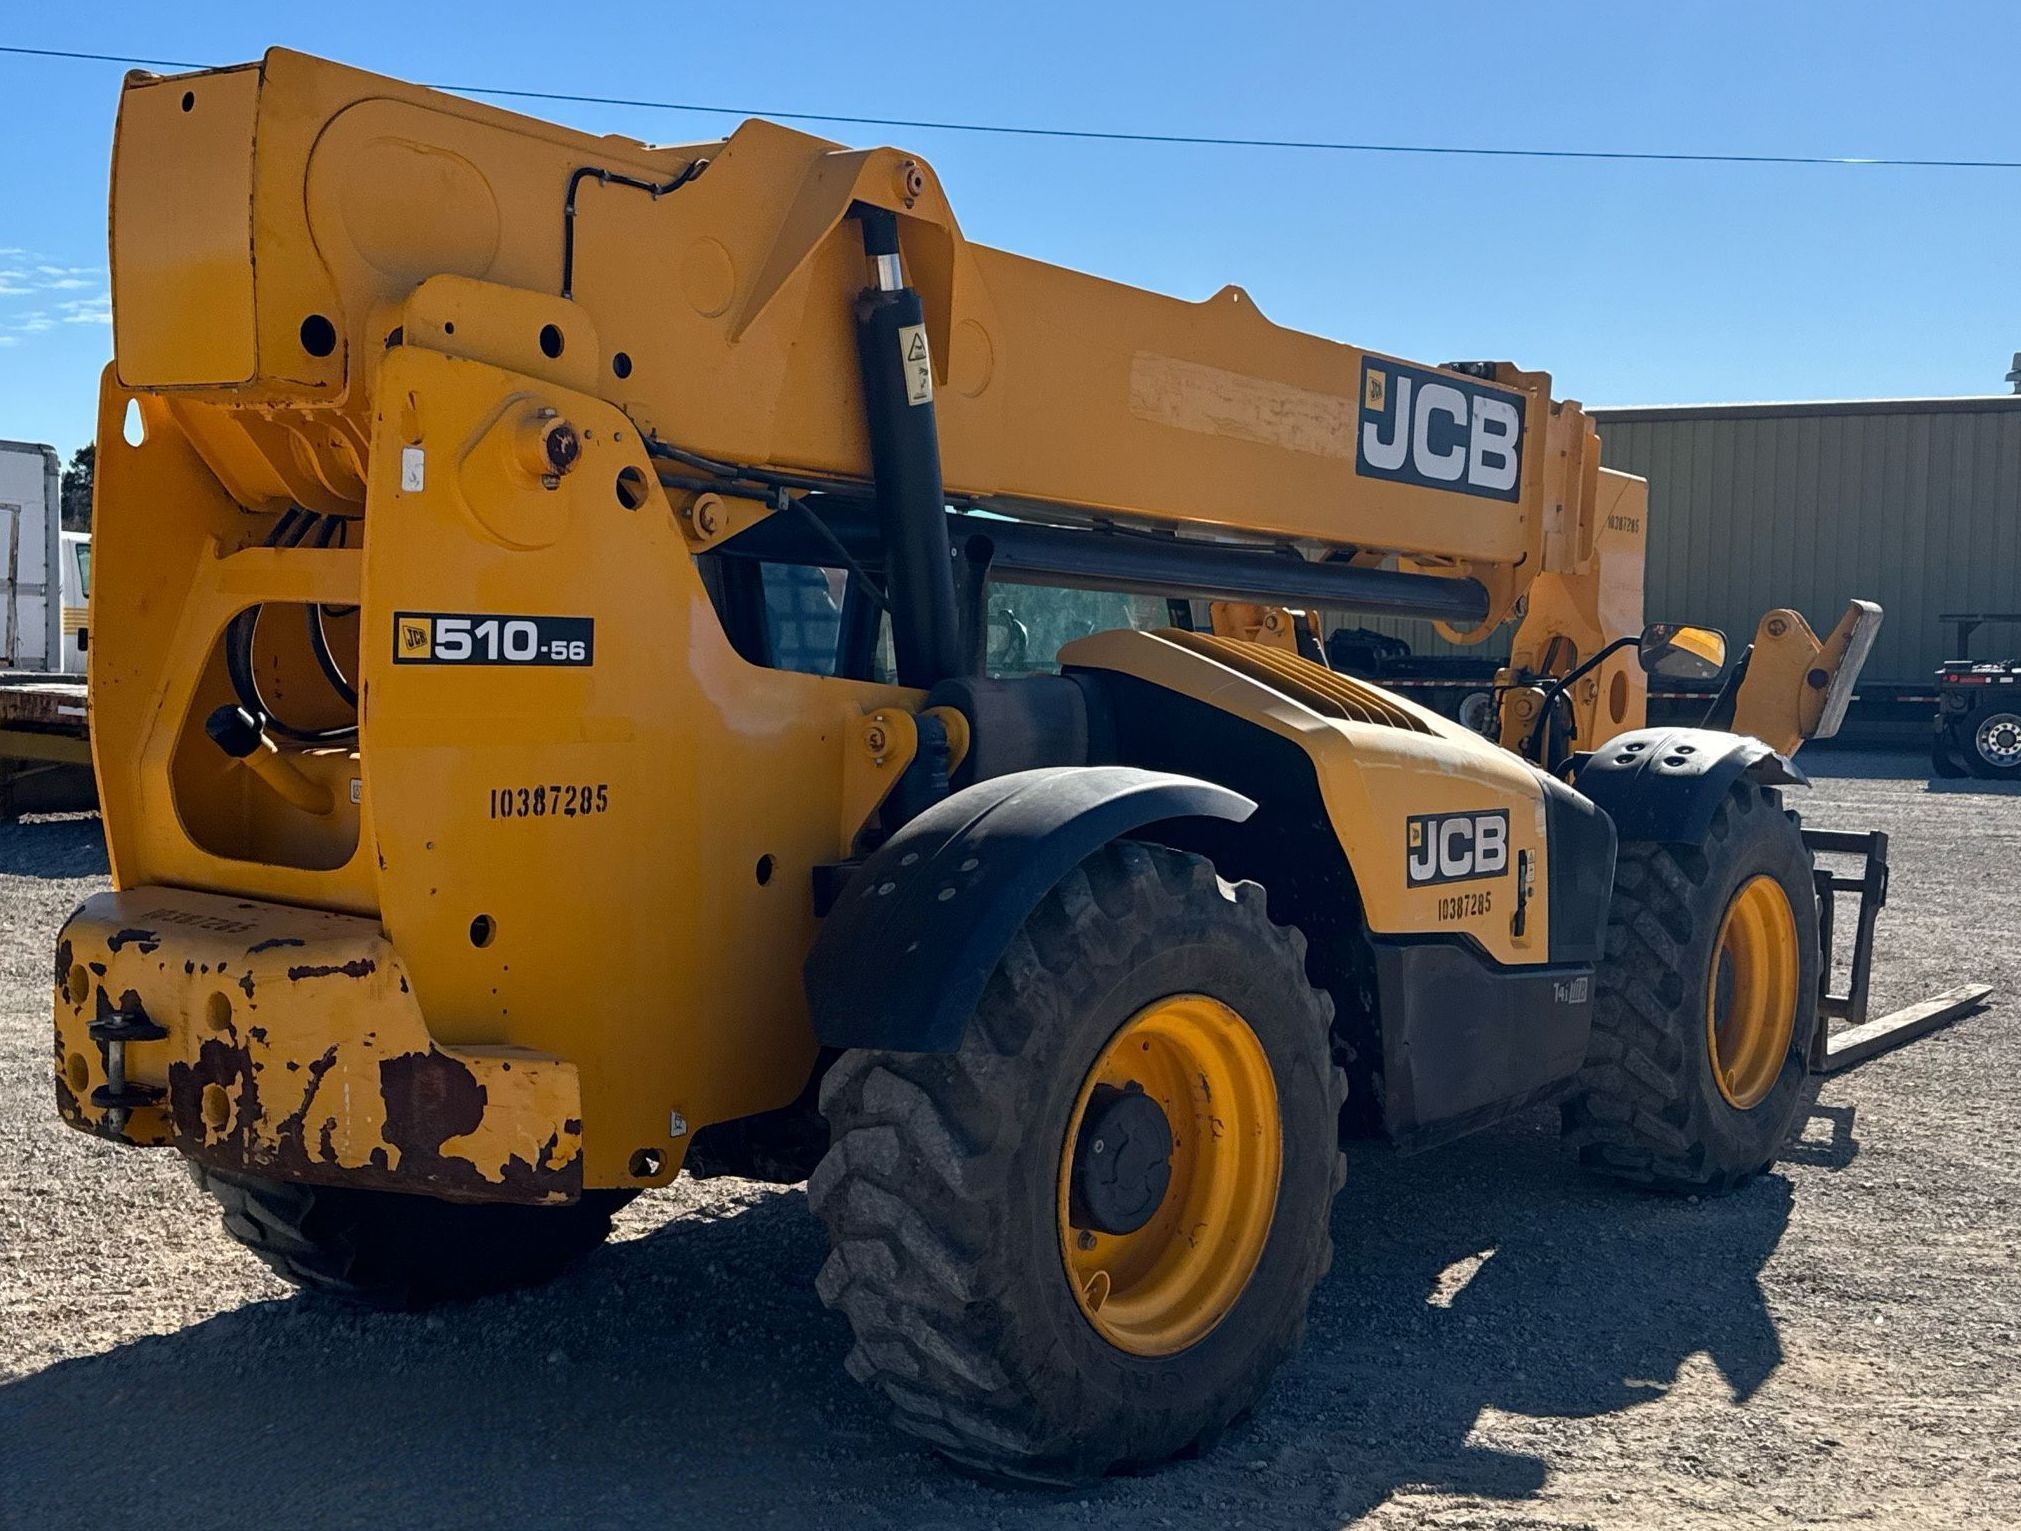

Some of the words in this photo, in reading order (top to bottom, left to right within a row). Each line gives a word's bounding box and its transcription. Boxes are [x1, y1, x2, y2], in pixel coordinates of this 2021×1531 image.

[1363, 376, 1519, 490] JCB
[402, 625, 427, 650] JCB
[491, 784, 607, 819] 10387285
[1410, 815, 1507, 881] JCB
[1438, 891, 1491, 921] 10387285
